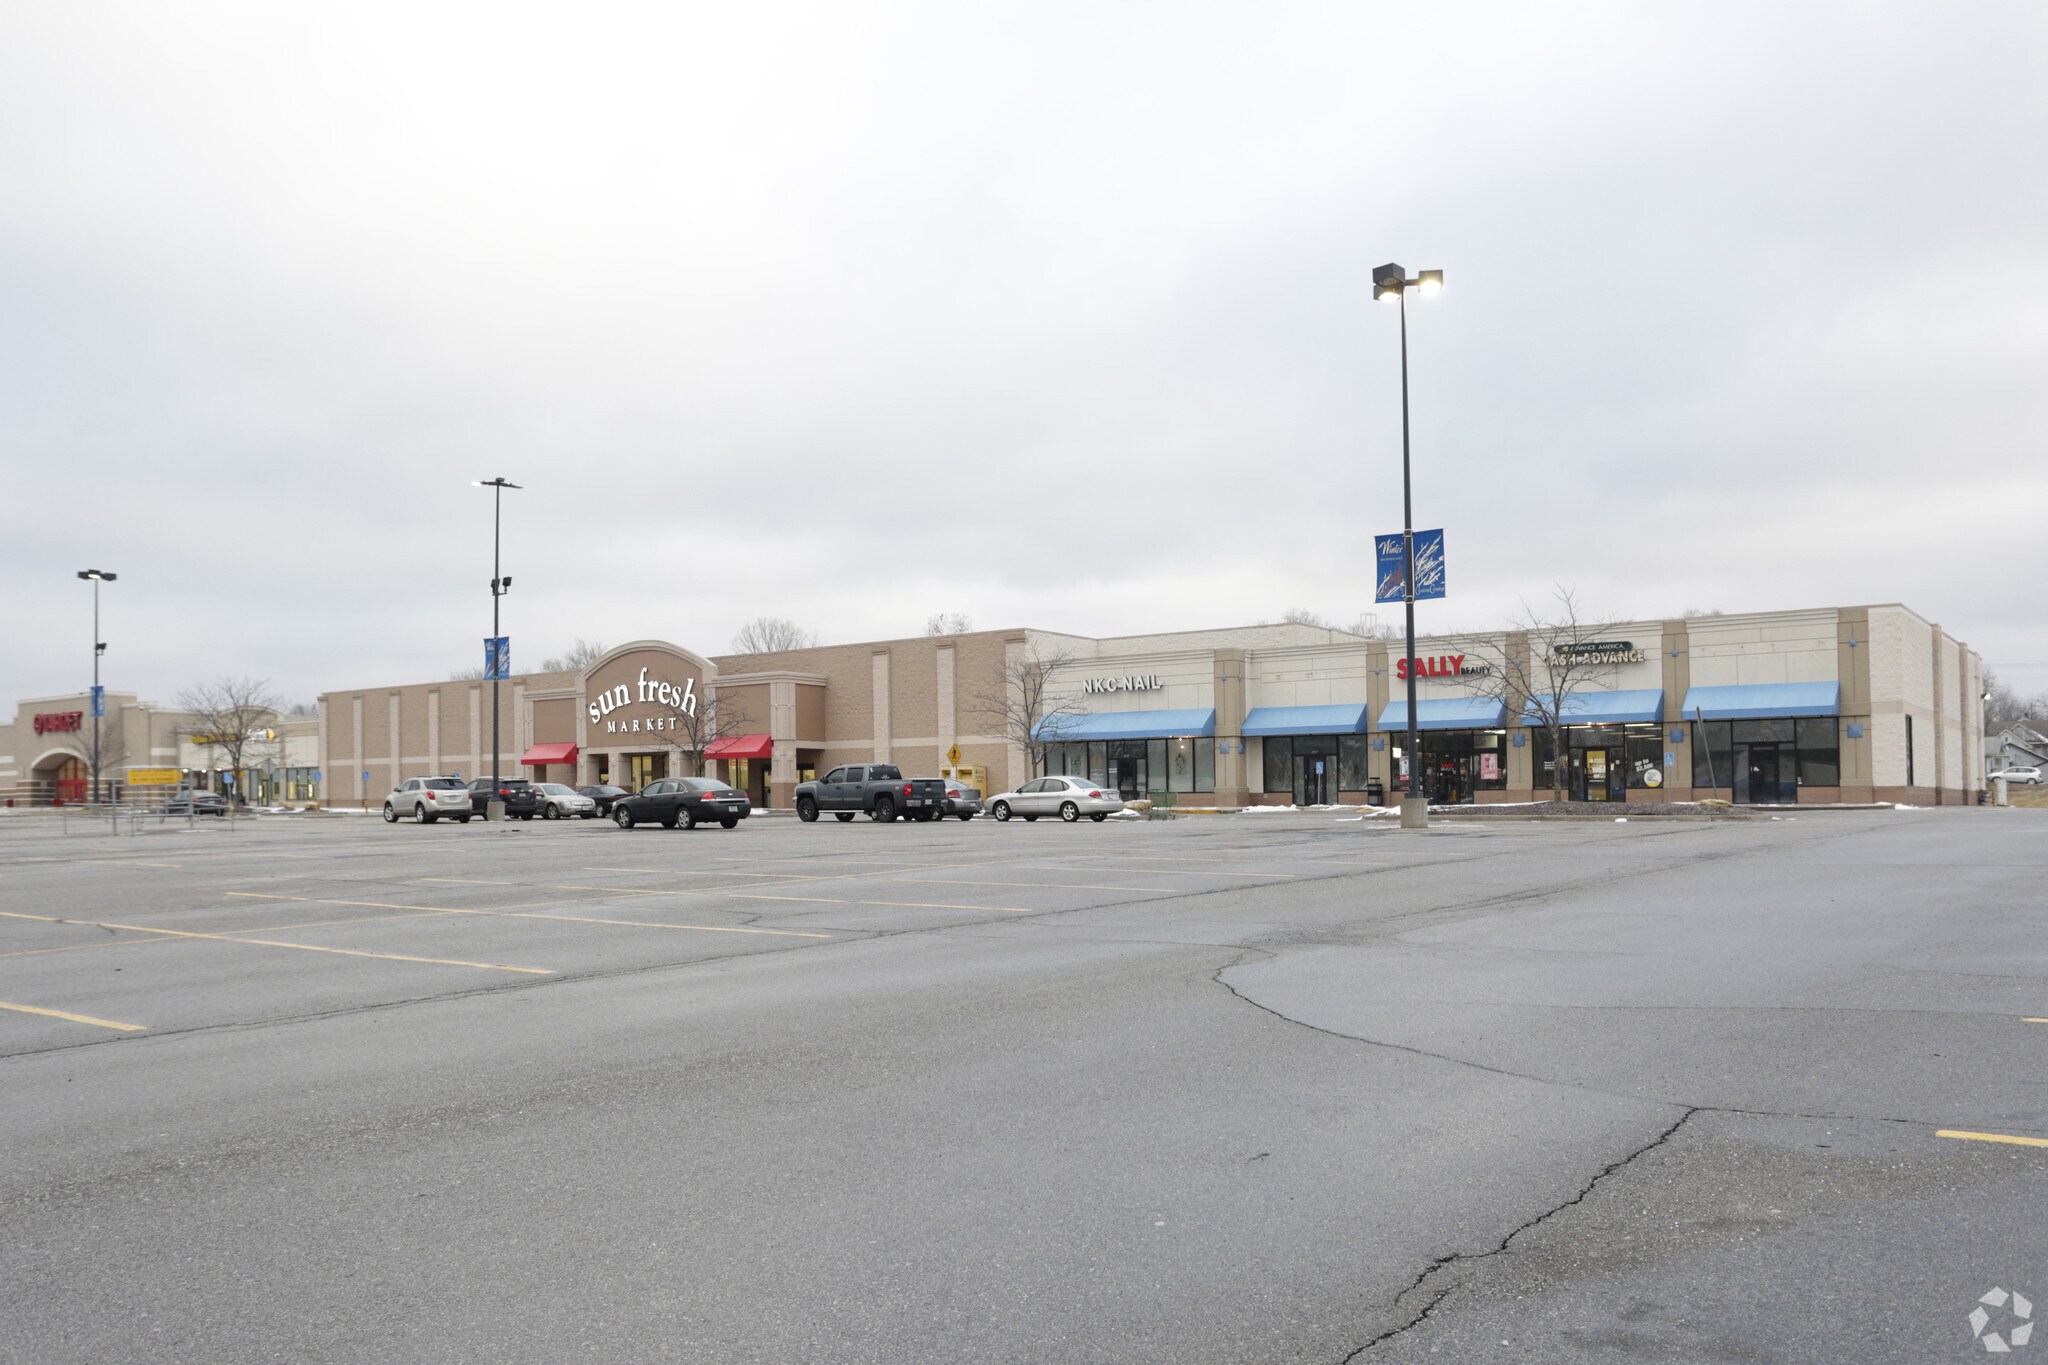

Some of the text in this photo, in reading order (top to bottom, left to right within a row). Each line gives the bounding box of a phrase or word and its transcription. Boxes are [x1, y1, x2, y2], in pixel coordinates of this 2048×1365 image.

[1582, 649, 1646, 665] ADVANCE
[1396, 655, 1466, 680] SALLY
[1461, 665, 1492, 675] BEAUTY
[1082, 674, 1162, 694] NKC NAIL
[589, 667, 698, 724] sun fresh
[607, 717, 677, 734] MARKET
